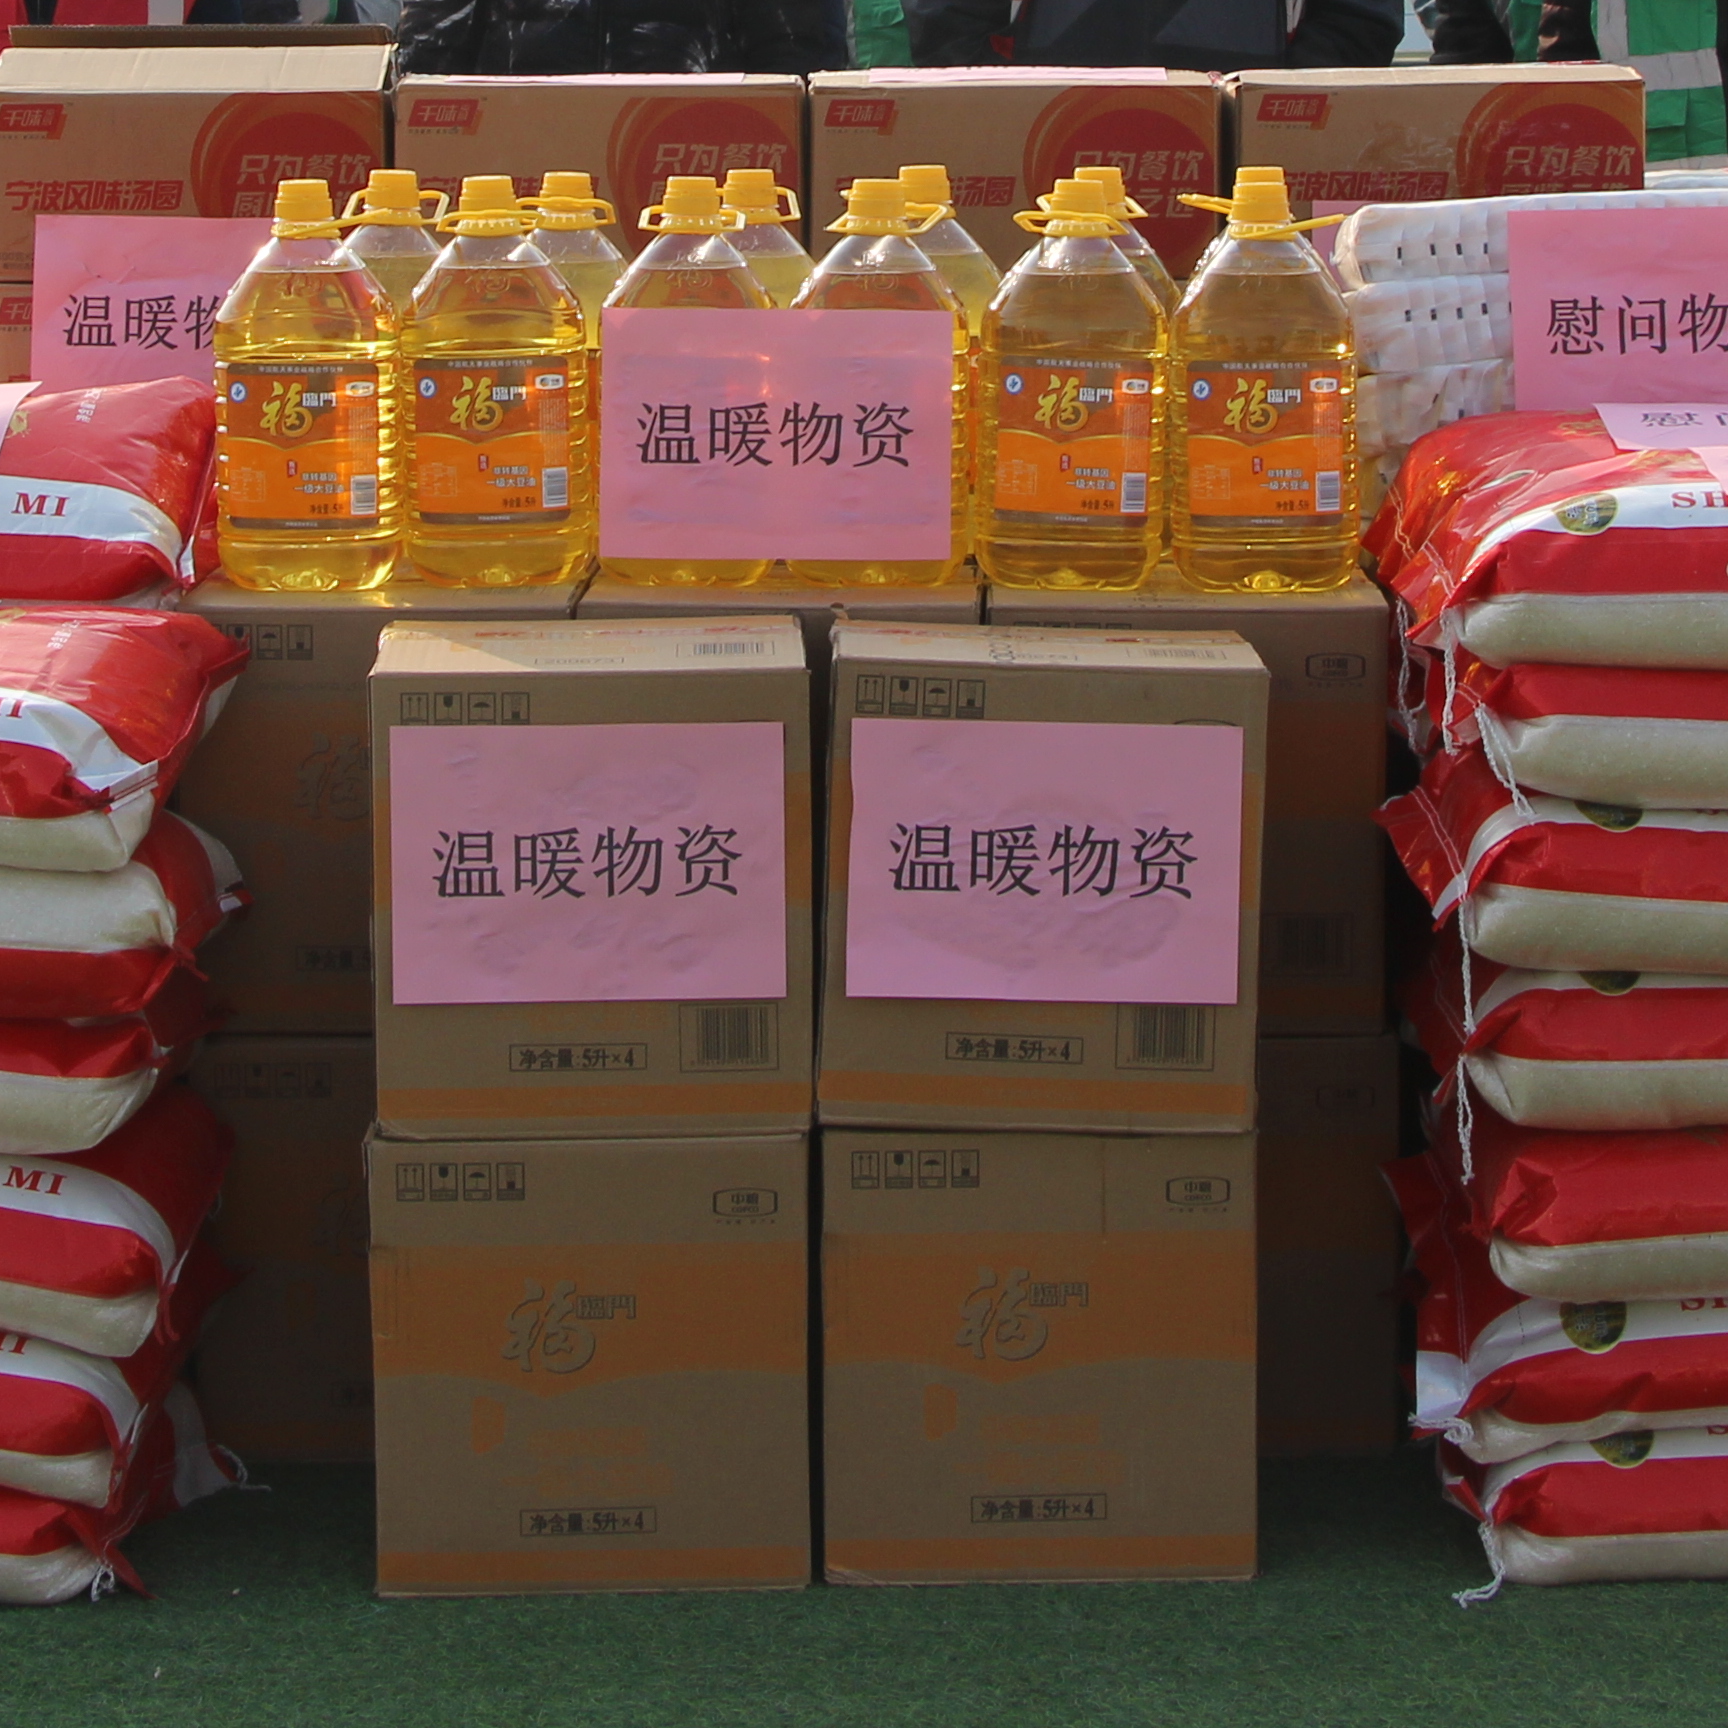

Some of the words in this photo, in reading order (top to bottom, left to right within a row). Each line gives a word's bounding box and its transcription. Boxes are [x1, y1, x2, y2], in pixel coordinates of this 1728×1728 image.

[238, 154, 371, 185] 只为餐饮
[654, 143, 786, 173] 只为餐饮
[1504, 145, 1636, 175] 只为餐饮
[5, 180, 184, 211] 宁波风味汤圆
[636, 402, 914, 468] 温暖物资
[294, 483, 345, 494] 一级大豆油
[485, 477, 537, 488] 一级大豆油
[1065, 478, 1117, 491] 一级大豆油
[1259, 479, 1310, 491] 一级大豆油
[11, 491, 70, 517] MI
[432, 824, 744, 902] 温暖物资
[888, 821, 1199, 902] 温暖物资
[3, 1166, 68, 1196] MI
